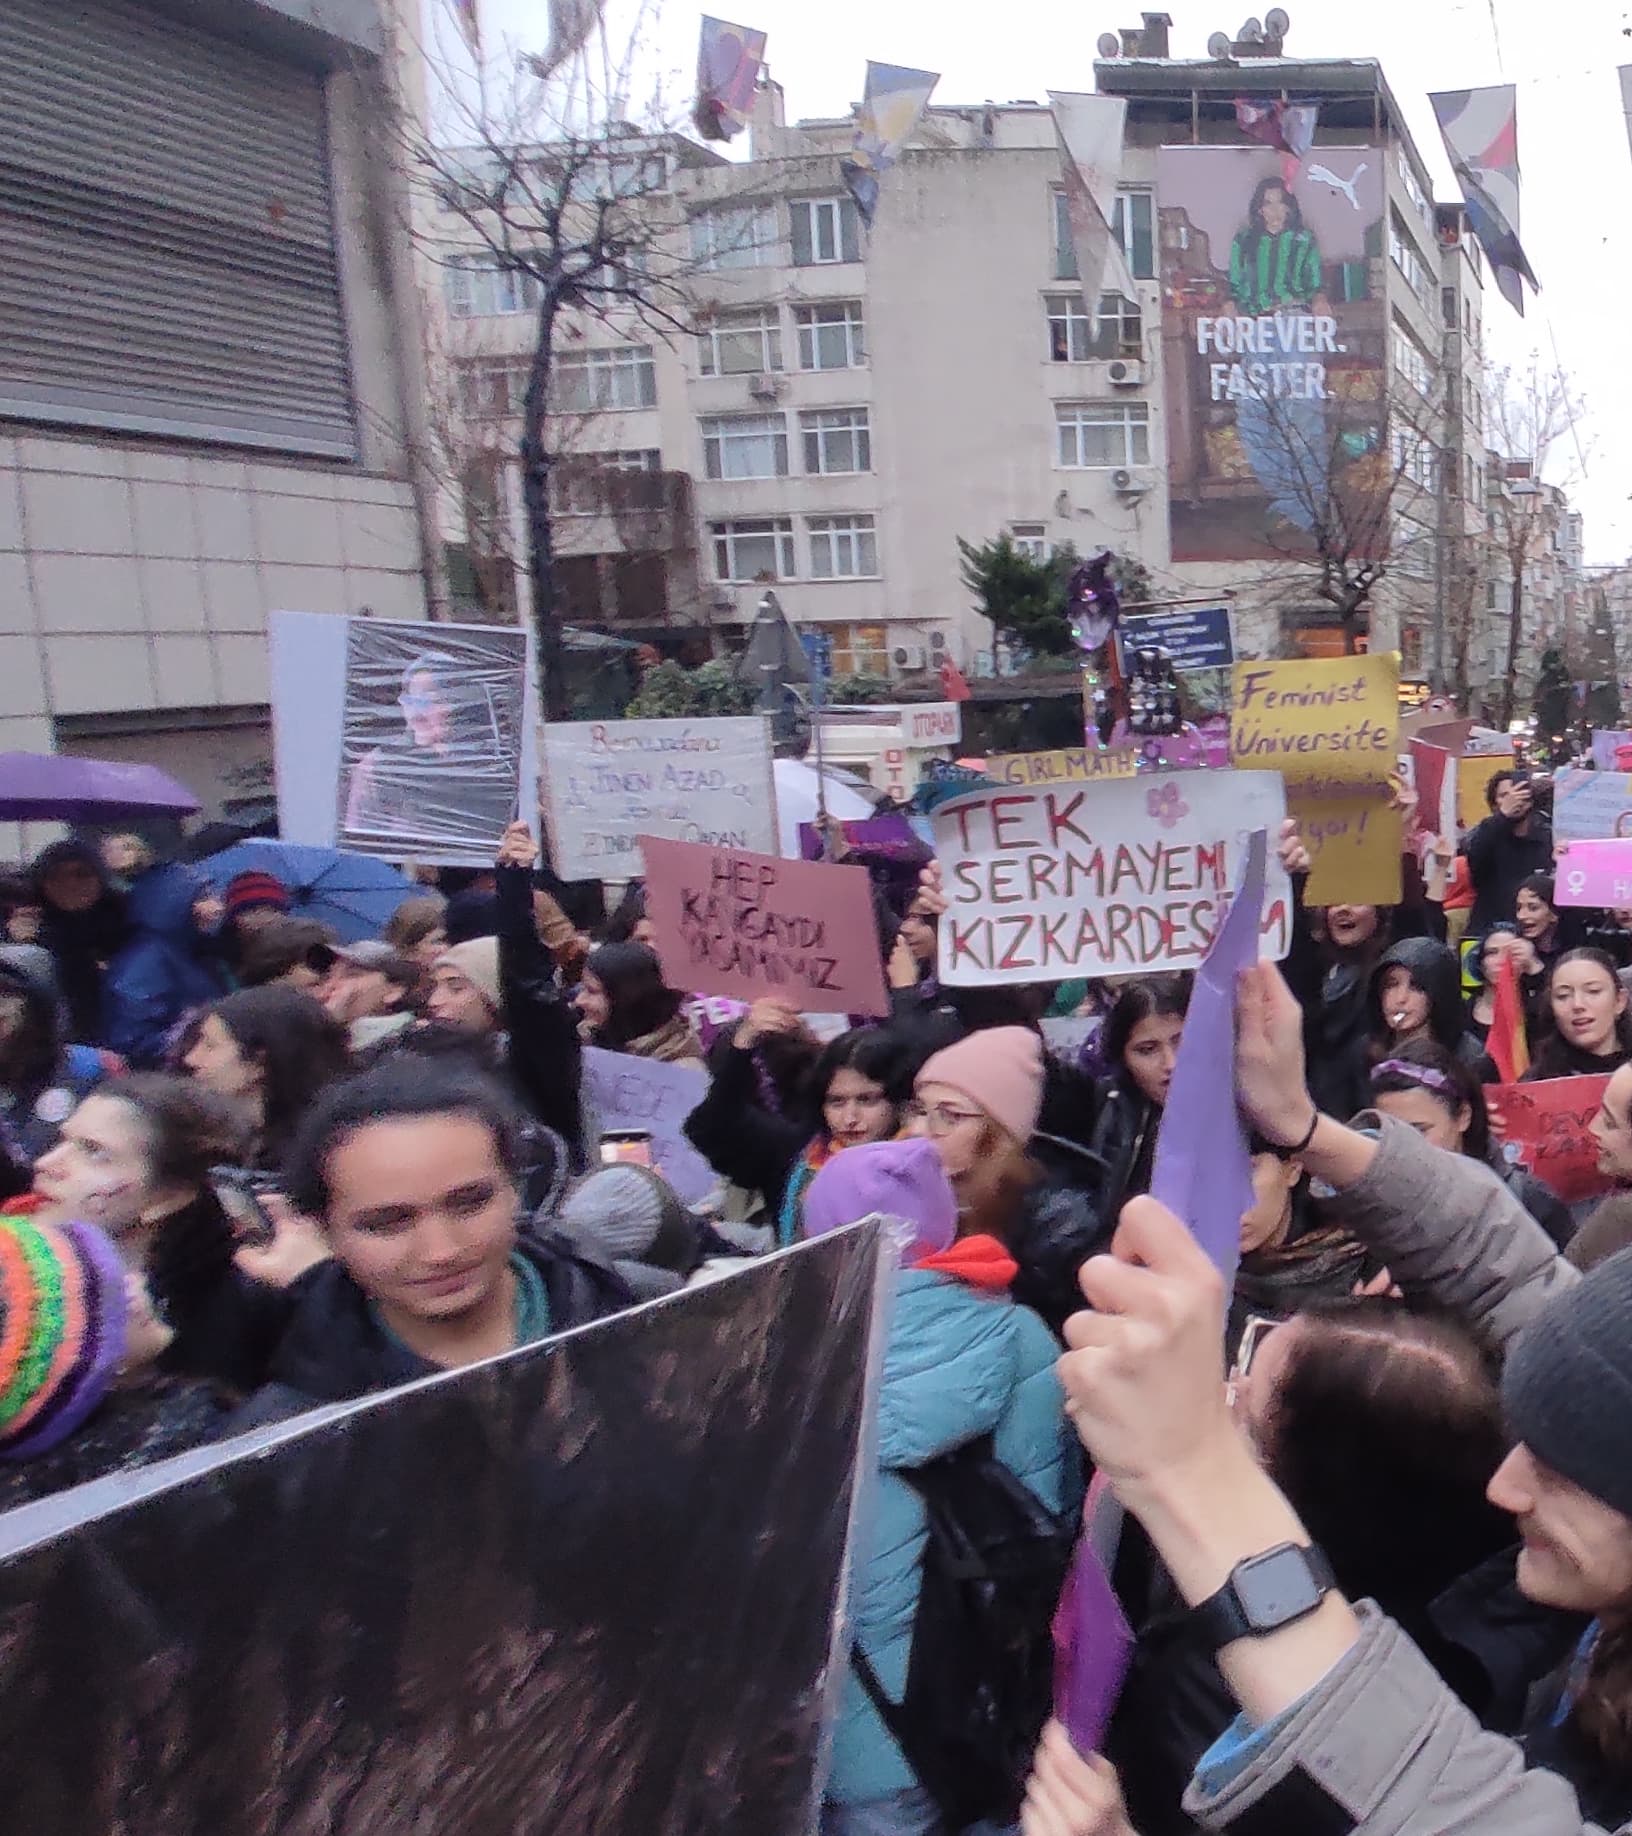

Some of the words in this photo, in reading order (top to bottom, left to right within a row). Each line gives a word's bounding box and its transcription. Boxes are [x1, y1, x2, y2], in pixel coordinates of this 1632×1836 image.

[1197, 314, 1347, 354] FOREVER.
[1210, 362, 1336, 401] FASTER.
[1242, 670, 1366, 709] Feminist
[1236, 719, 1390, 756] Üniversite
[941, 791, 1093, 852] TEK
[711, 855, 775, 903] HEP
